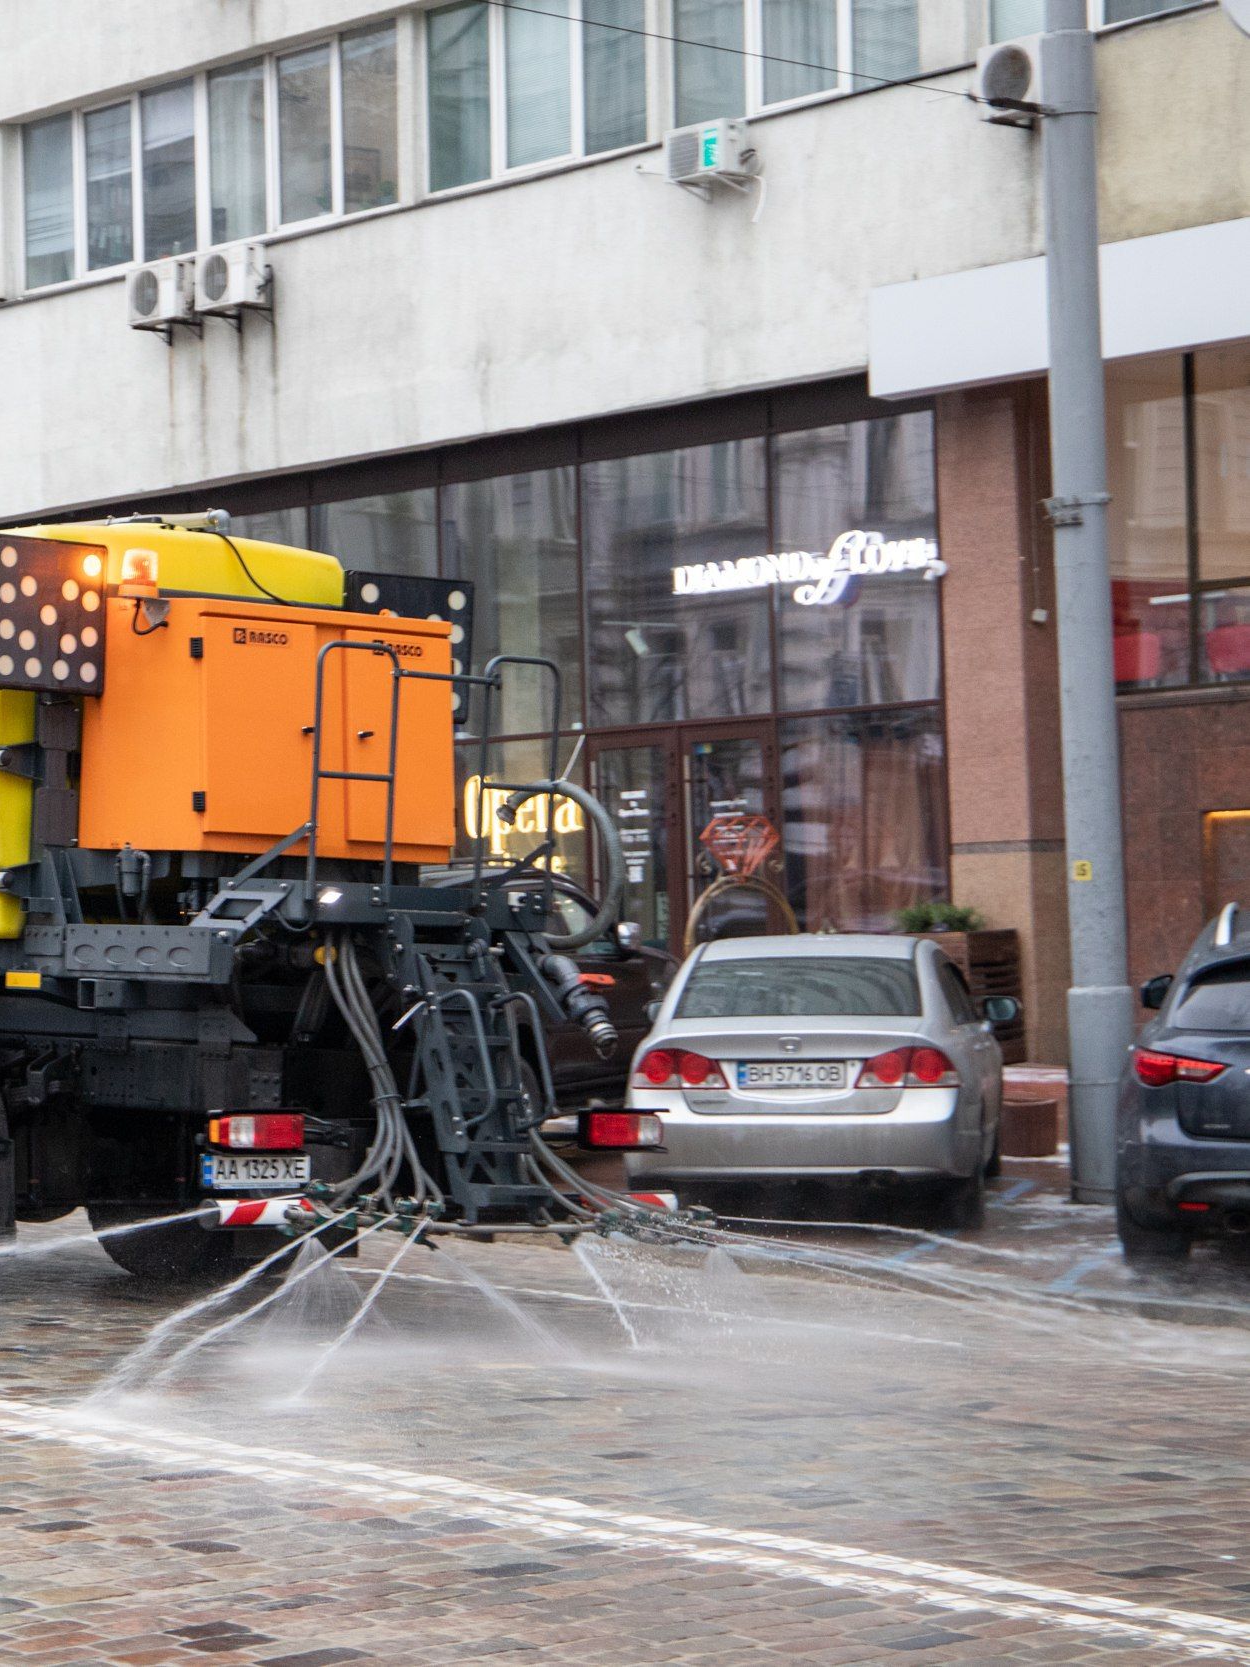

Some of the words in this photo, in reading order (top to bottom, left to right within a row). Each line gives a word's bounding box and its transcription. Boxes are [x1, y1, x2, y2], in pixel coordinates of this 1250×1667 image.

[250, 631, 288, 645] RASCO
[388, 643, 423, 657] ASCO
[750, 1066, 773, 1082] BH
[777, 1066, 813, 1082] 5716
[817, 1066, 841, 1082] OB
[216, 1159, 239, 1180] AA
[242, 1159, 279, 1180] 1325
[282, 1159, 305, 1180] XE
